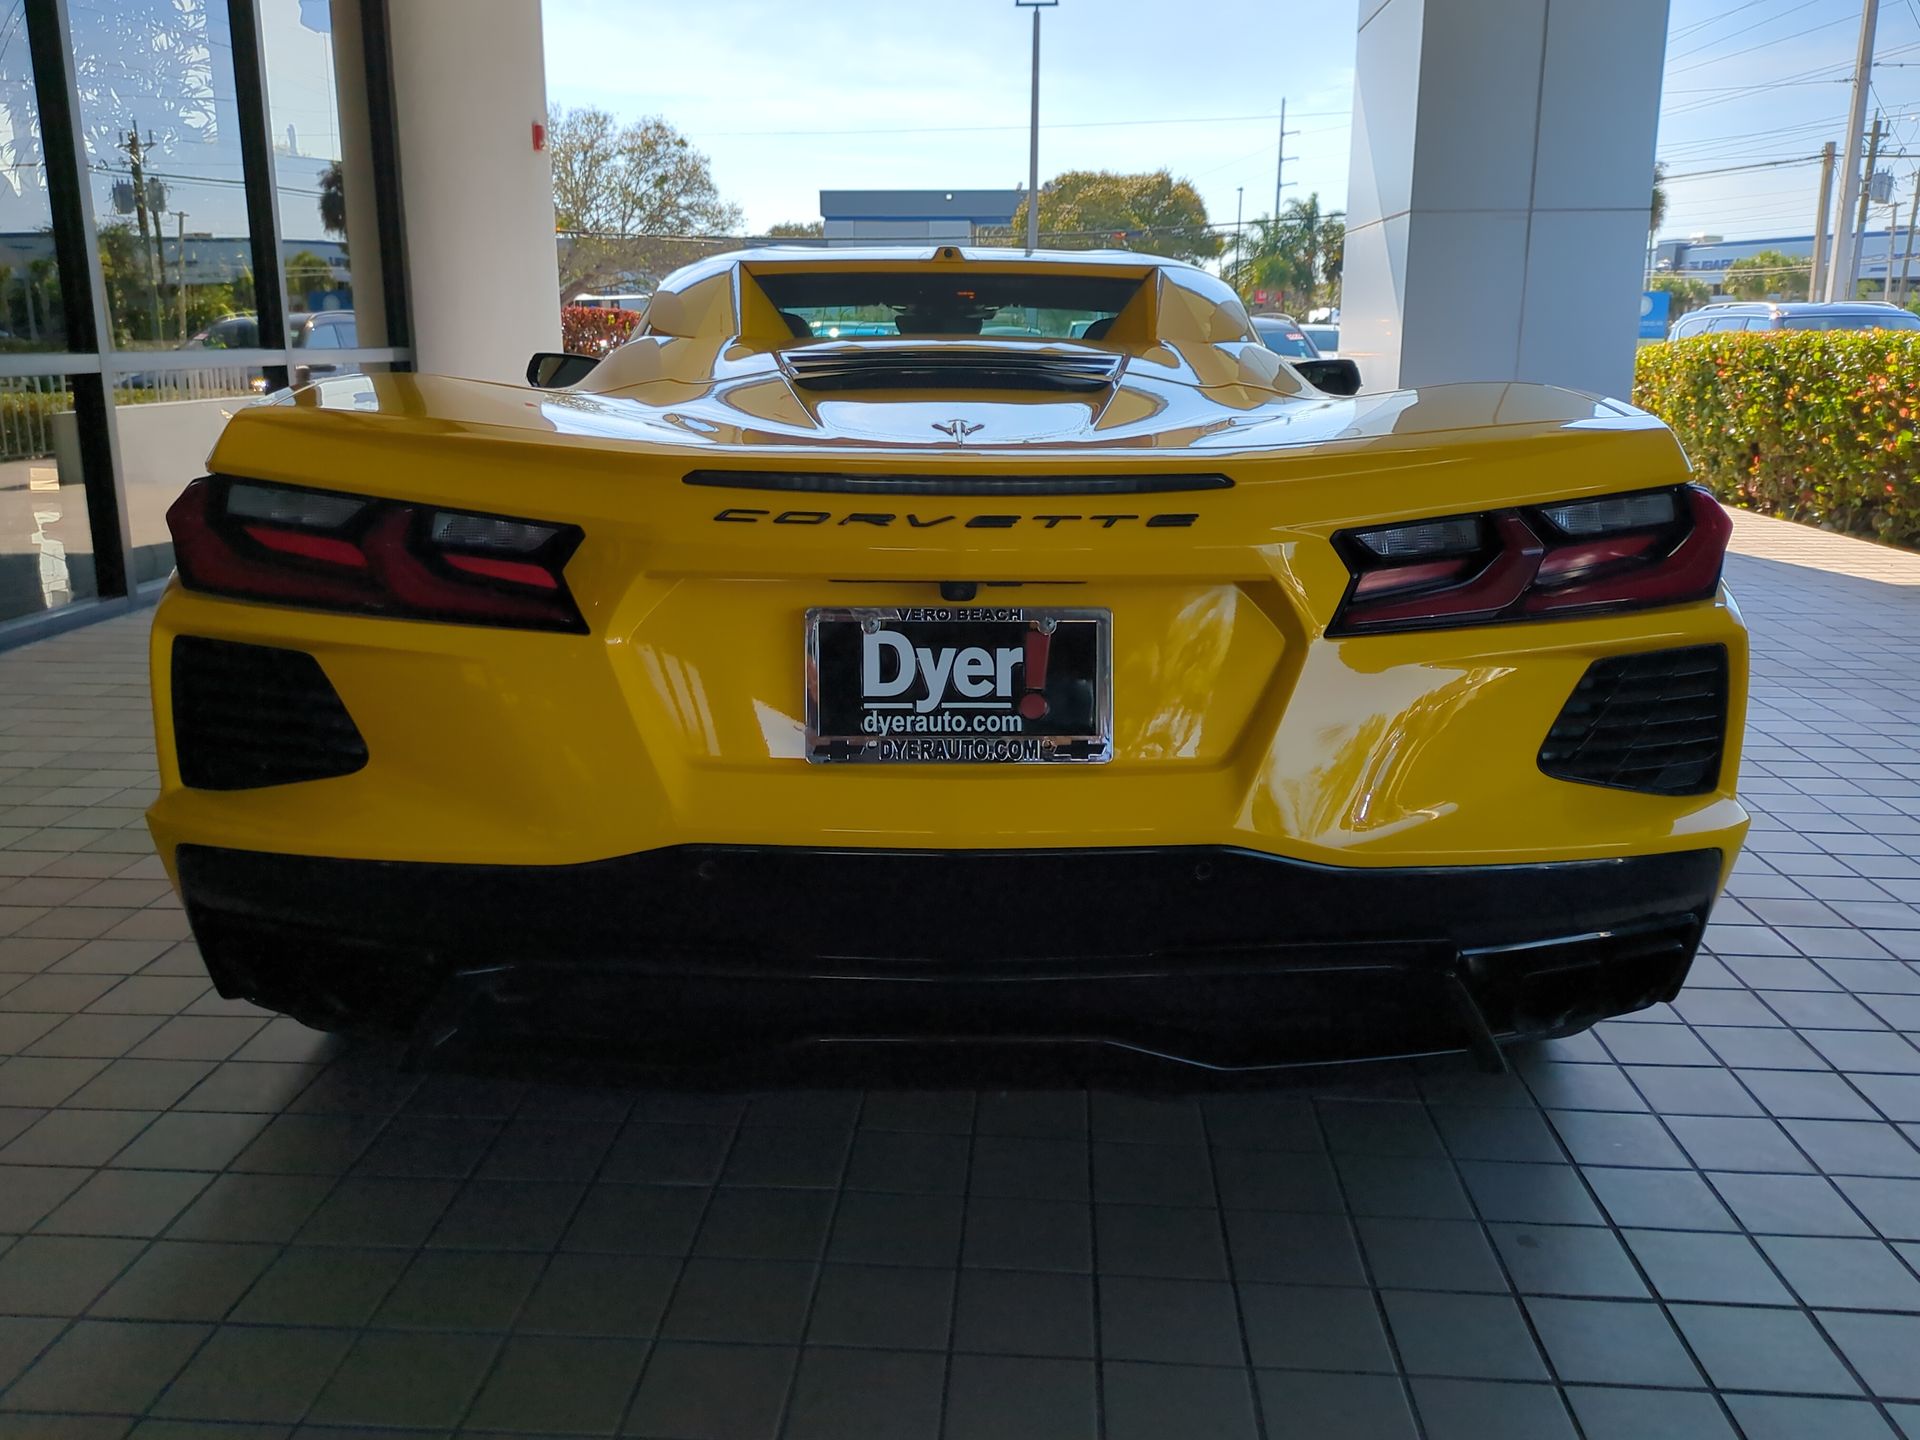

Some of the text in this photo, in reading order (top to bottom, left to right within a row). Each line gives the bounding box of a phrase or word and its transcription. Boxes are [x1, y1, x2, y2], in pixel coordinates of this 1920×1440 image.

[713, 508, 1200, 529] CORVETTE
[897, 608, 1024, 622] VERO BEACH
[862, 710, 1023, 737] dyerauto.com
[879, 738, 1041, 761] DYERAUTO.COM
